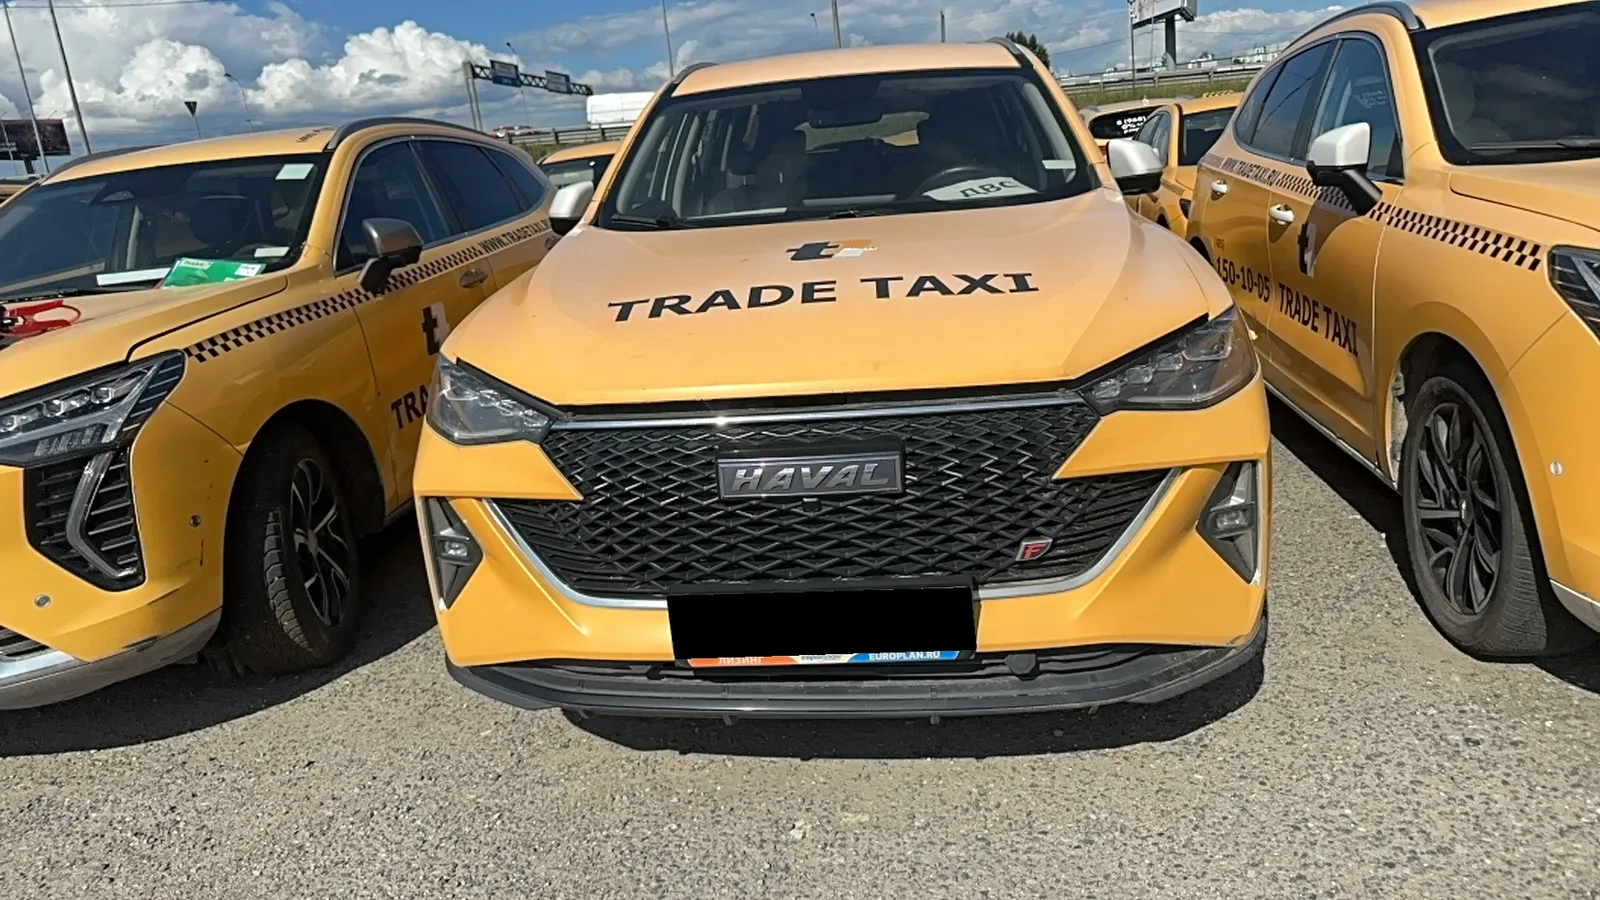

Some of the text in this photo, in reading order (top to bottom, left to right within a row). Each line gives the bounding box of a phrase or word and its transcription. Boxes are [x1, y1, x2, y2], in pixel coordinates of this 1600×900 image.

[960, 180, 1018, 198] ДВС
[477, 219, 550, 254] WWW.TRADETAXI.R
[607, 273, 1039, 322] TRADE TAXI
[1216, 256, 1271, 303] 150-10-05
[1278, 282, 1359, 357] TRADE TAXI
[390, 384, 429, 429] TRA
[731, 463, 889, 491] HAVAL
[868, 650, 941, 661] EUROPLAN.RU
